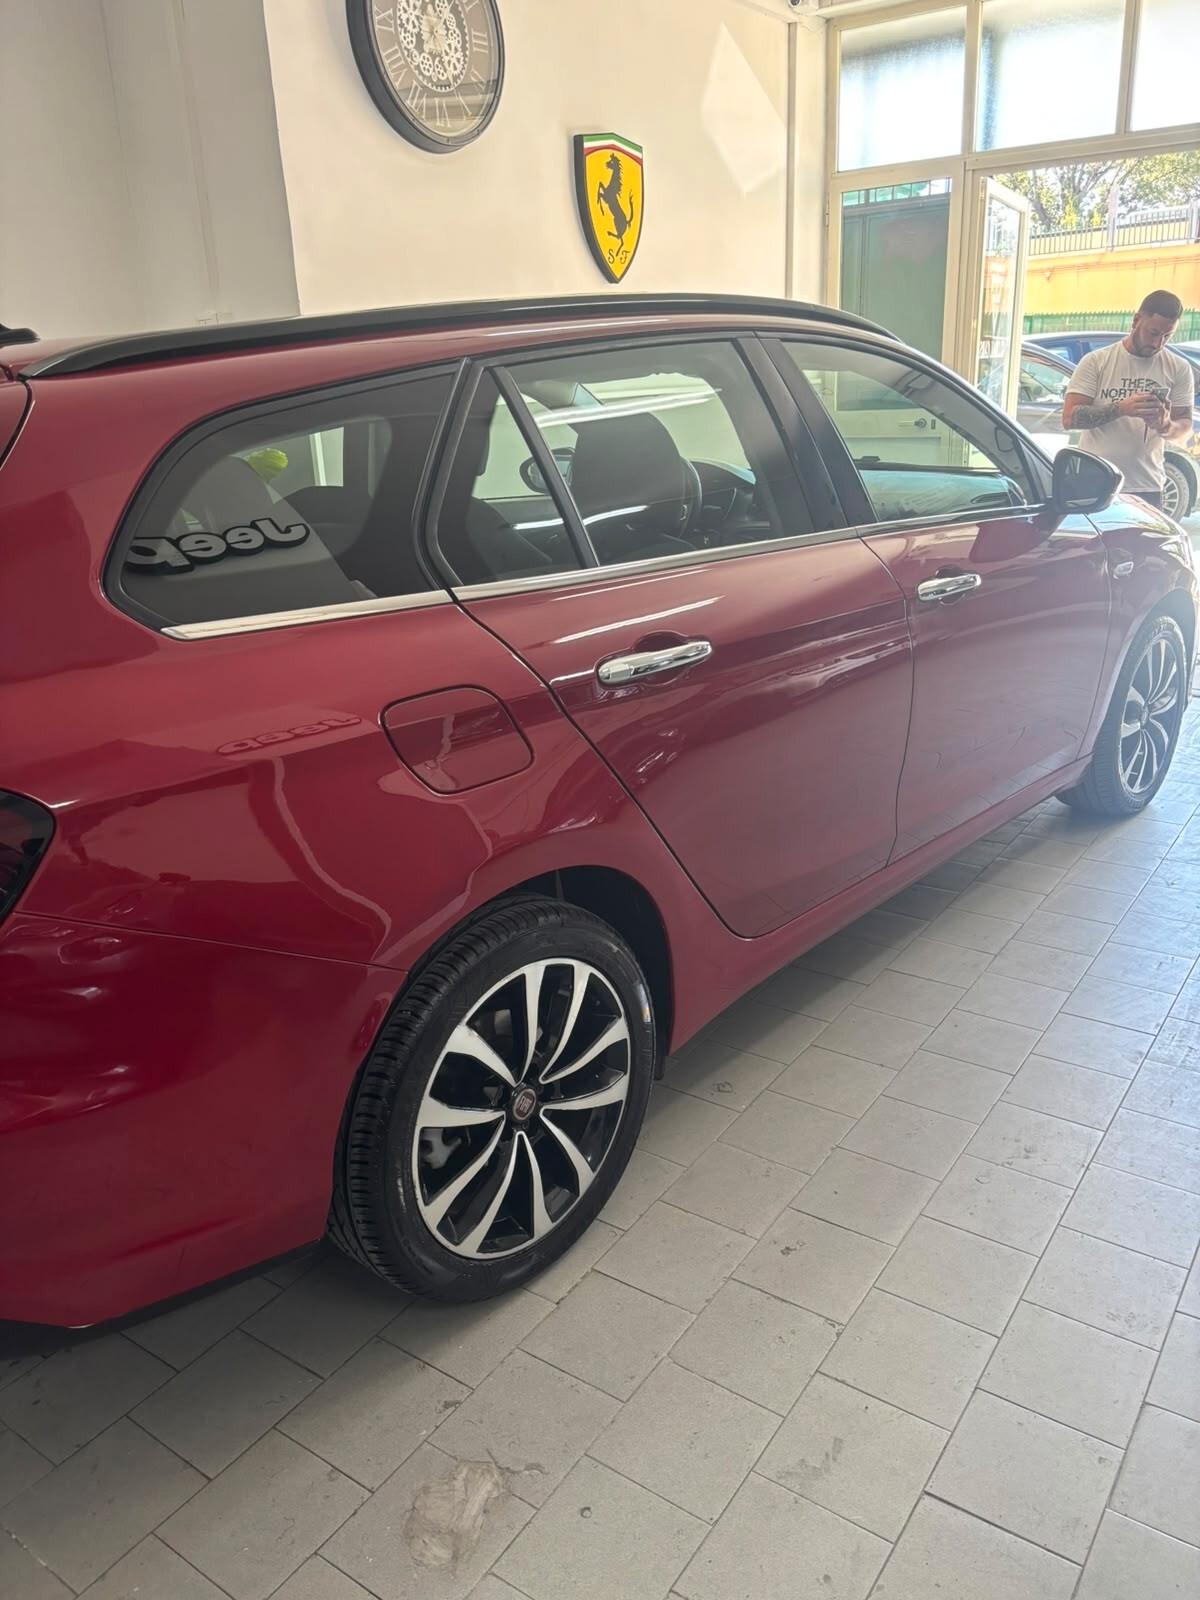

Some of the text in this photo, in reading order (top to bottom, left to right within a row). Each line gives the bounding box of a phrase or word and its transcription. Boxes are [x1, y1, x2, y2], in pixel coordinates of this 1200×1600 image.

[471, 28, 489, 54] III
[608, 248, 615, 264] S
[1121, 378, 1144, 389] THE
